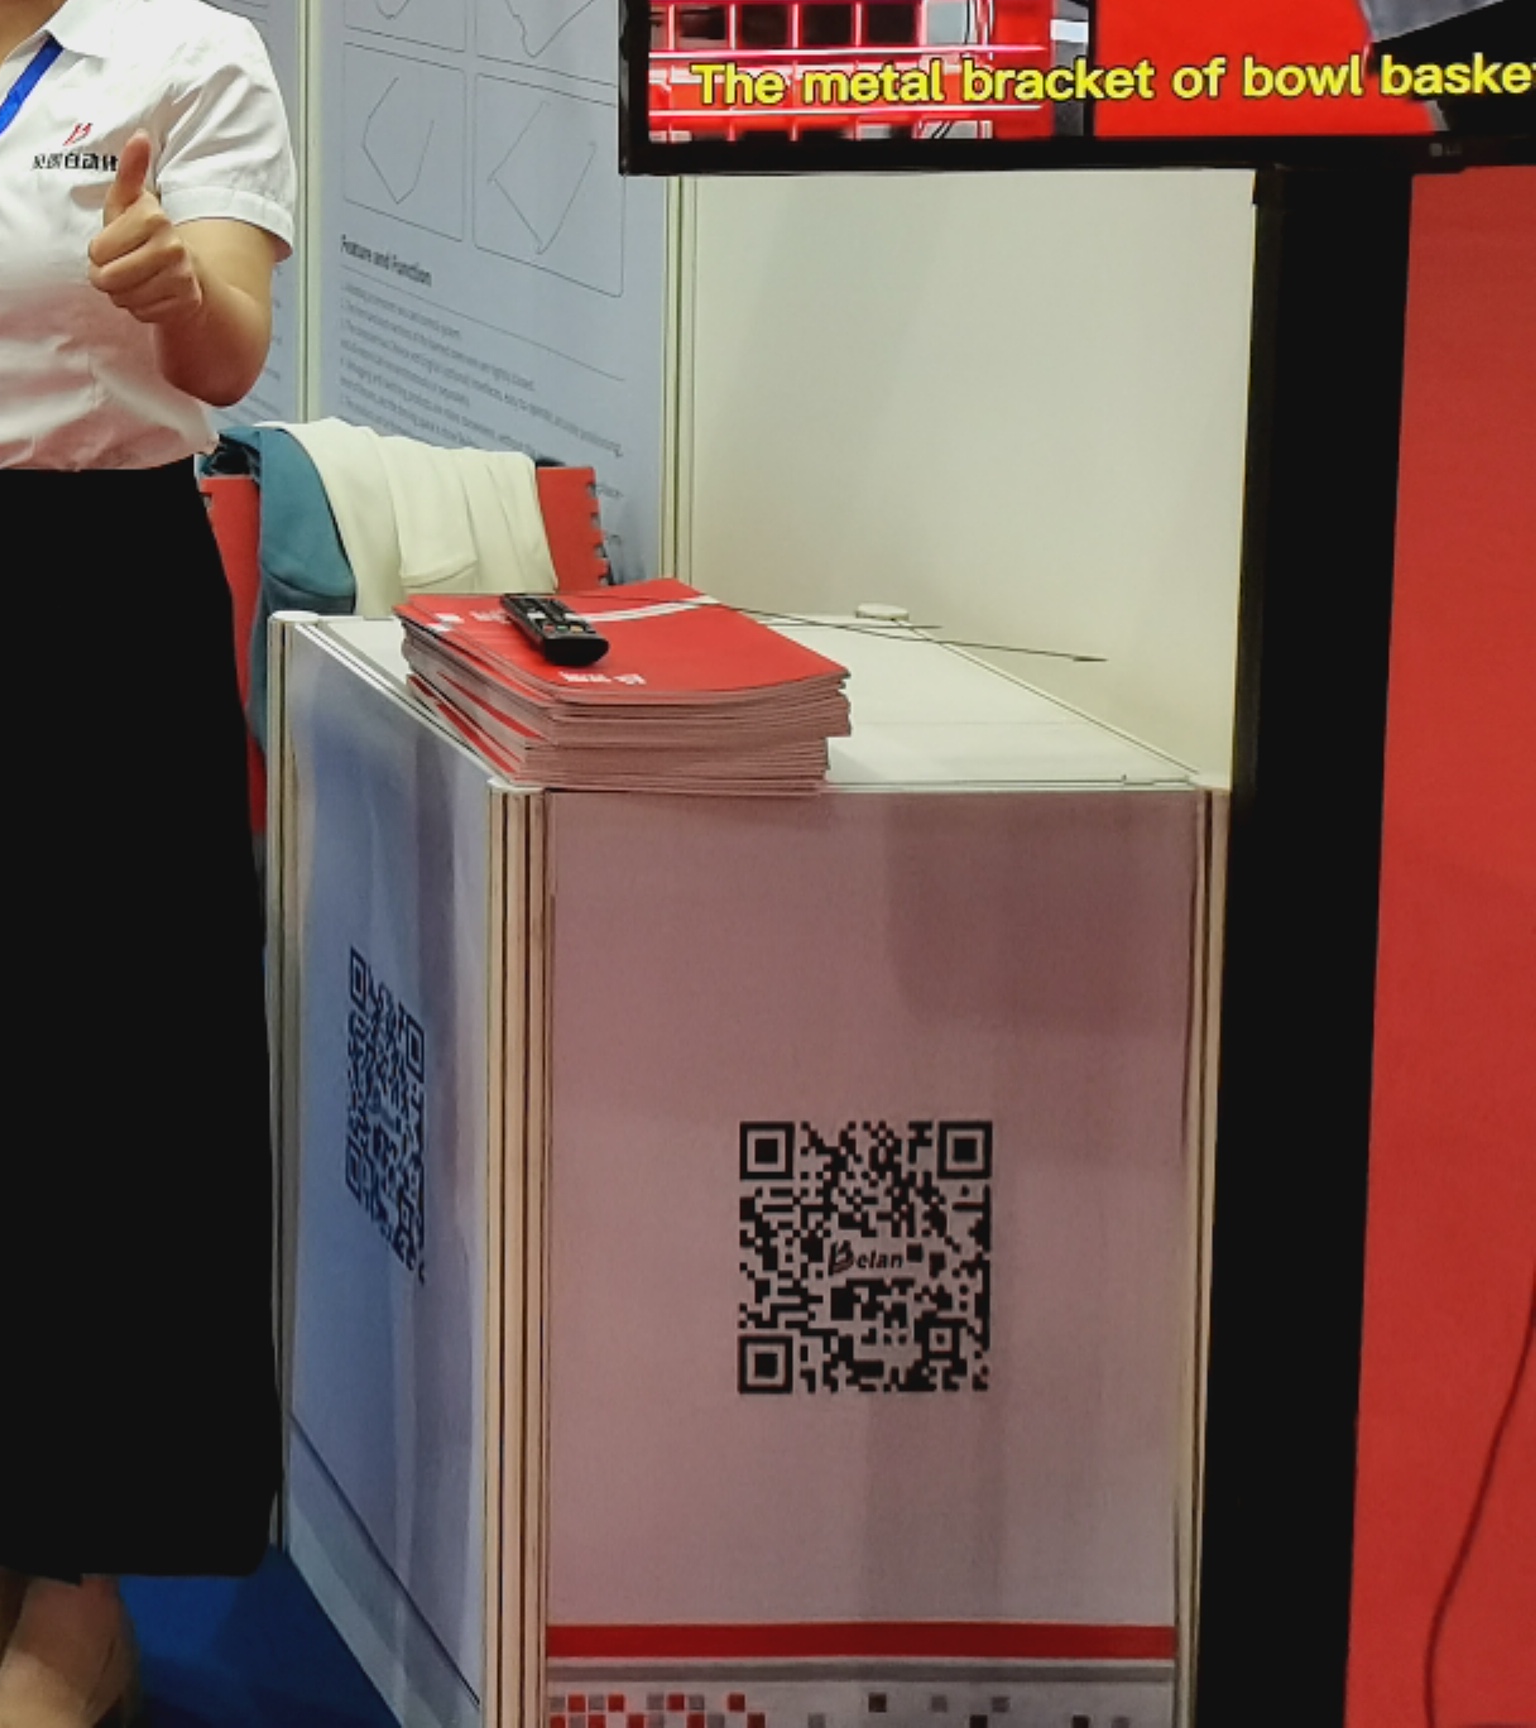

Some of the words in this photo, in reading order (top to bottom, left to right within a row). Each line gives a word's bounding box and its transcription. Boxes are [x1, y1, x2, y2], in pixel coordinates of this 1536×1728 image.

[691, 61, 784, 105] The
[802, 61, 945, 104] metal
[962, 58, 1154, 103] bracket
[1172, 57, 1227, 101] of
[1243, 54, 1364, 99] bowl
